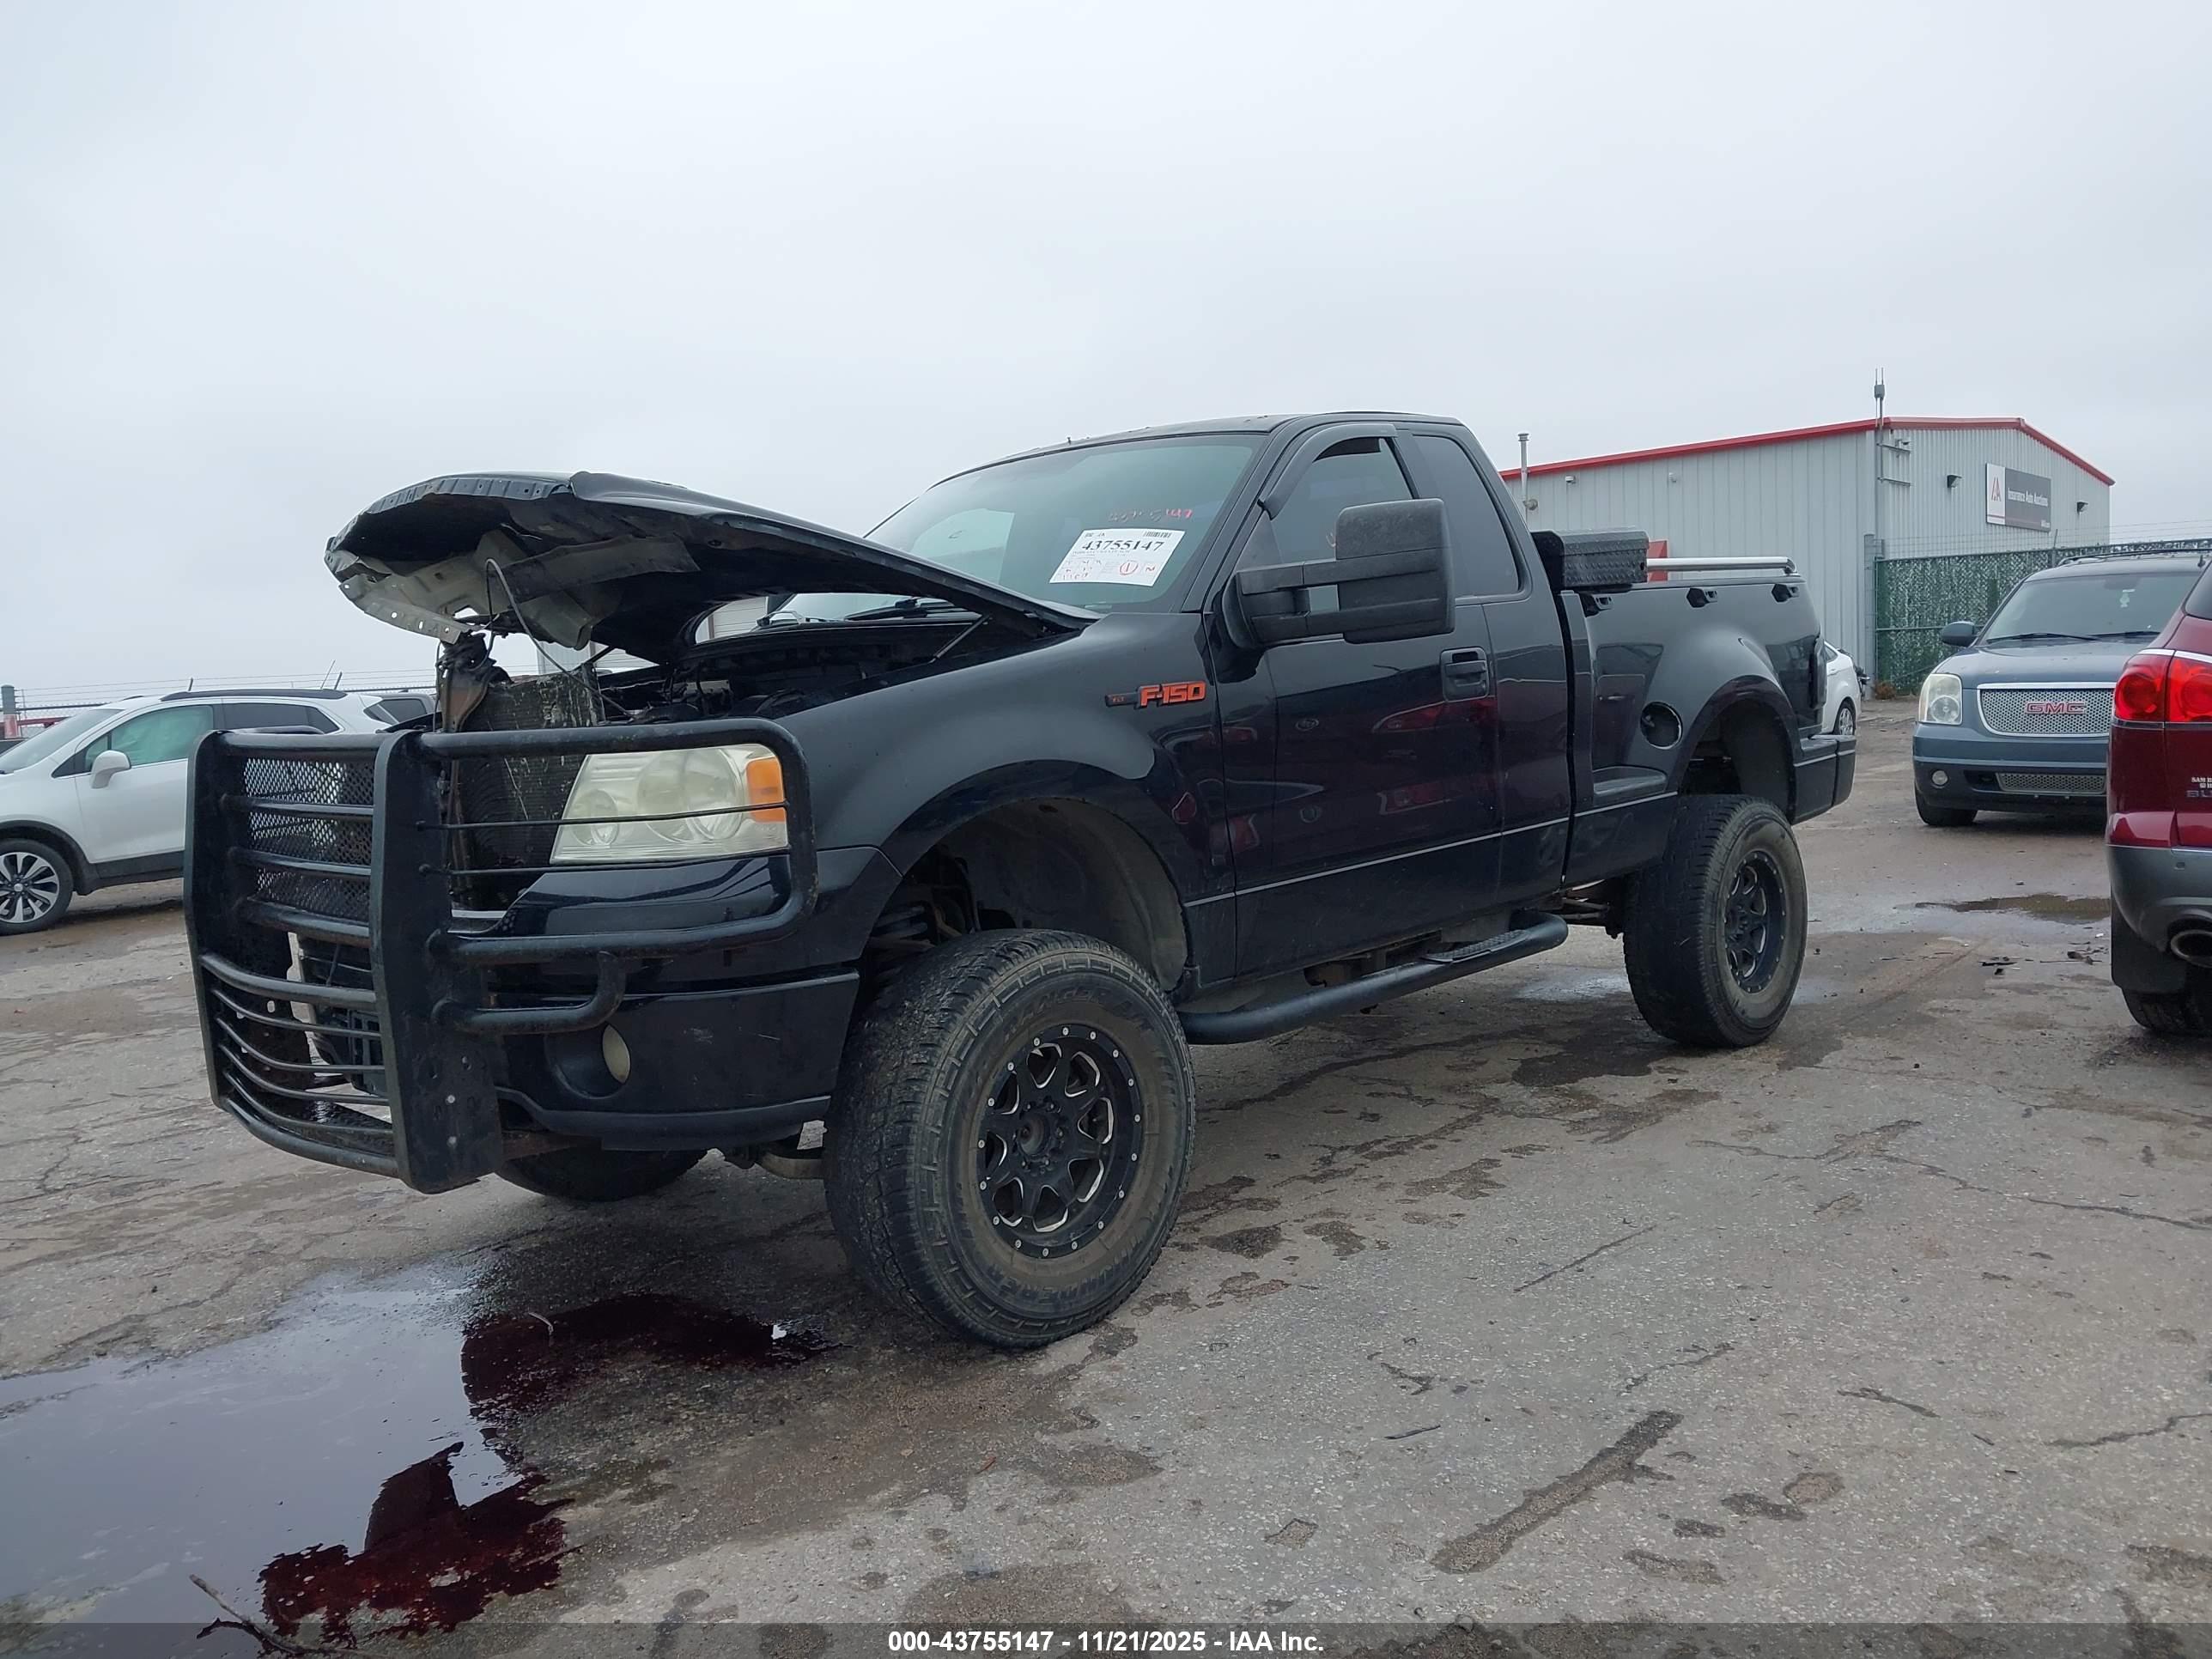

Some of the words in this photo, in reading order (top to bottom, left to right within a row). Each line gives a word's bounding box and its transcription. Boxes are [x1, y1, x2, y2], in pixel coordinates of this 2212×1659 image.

[1081, 539, 1165, 551] 43755147
[1139, 682, 1206, 707] F-150
[2026, 701, 2087, 714] GMC
